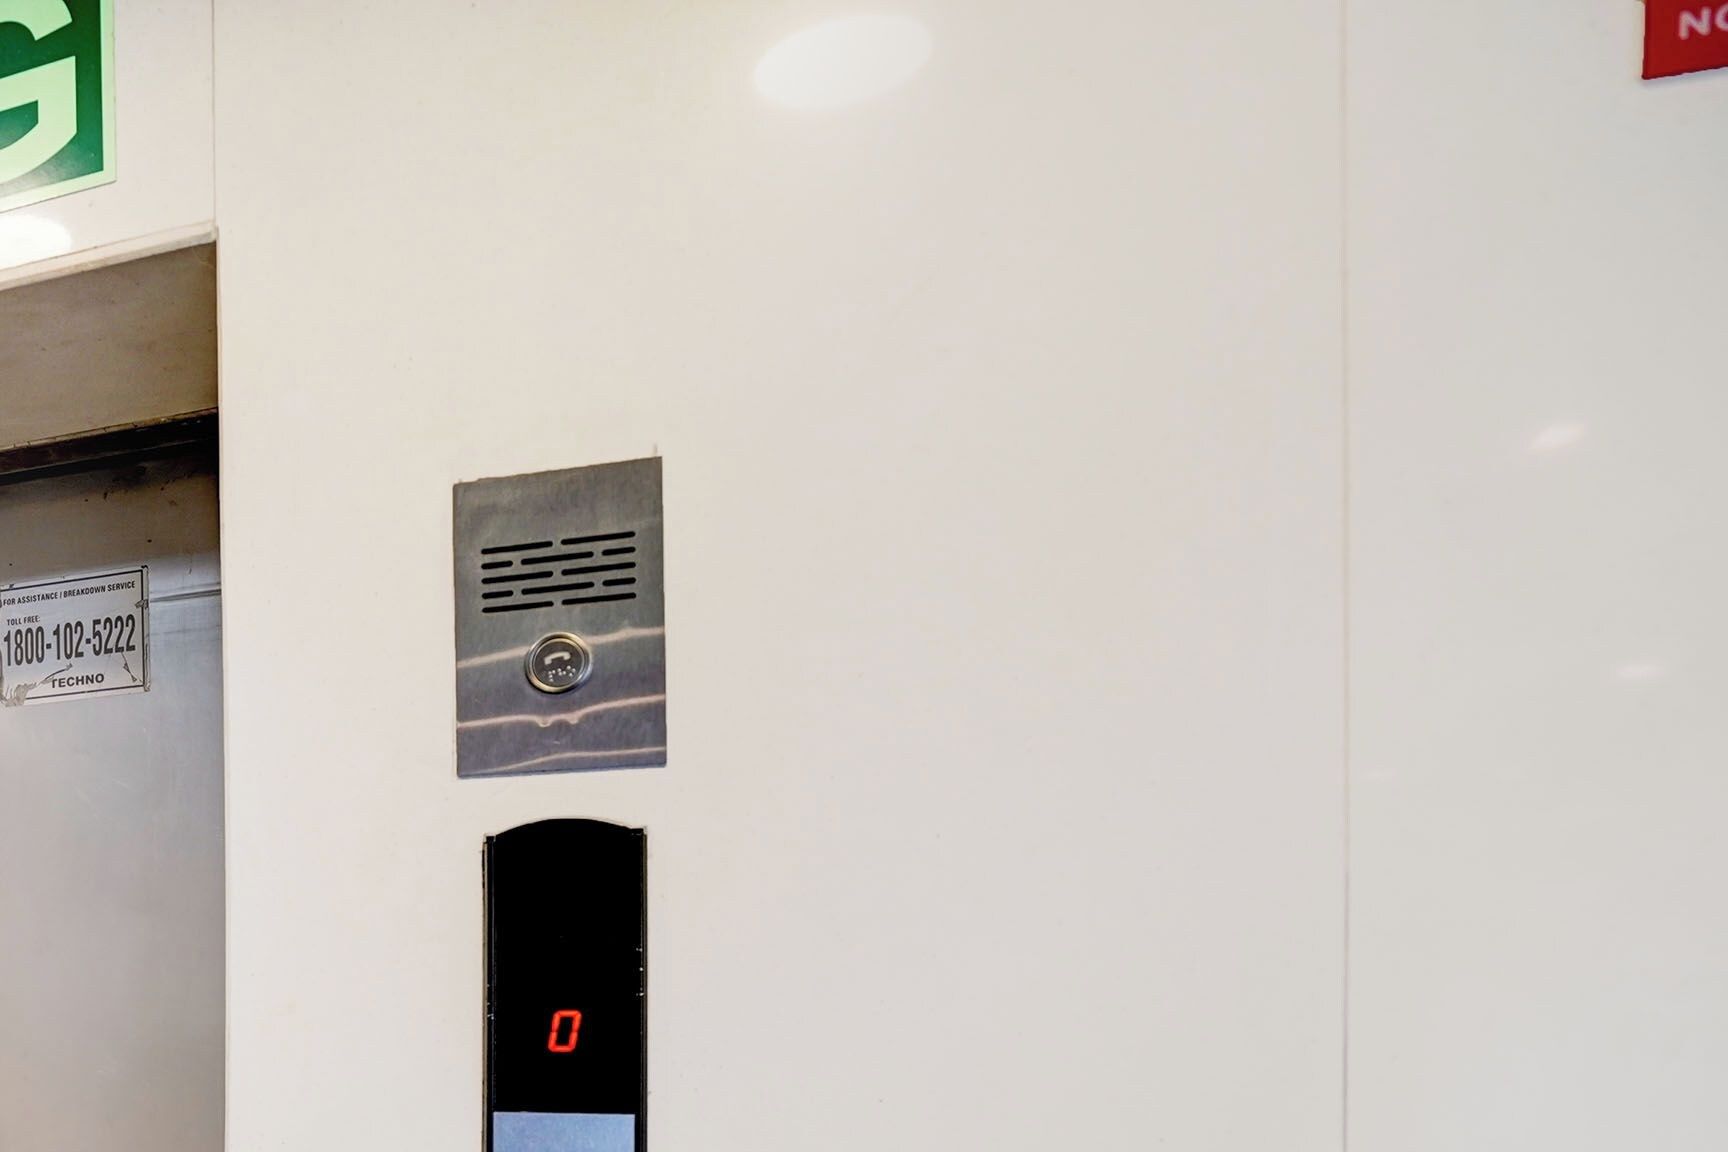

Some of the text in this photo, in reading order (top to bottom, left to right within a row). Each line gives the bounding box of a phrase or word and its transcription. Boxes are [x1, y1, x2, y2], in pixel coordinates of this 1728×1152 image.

[3, 598, 16, 606] FOR
[17, 592, 58, 604] ASSISTANCE
[63, 584, 106, 598] BREAKDOWN
[107, 580, 136, 592] SERVICE
[7, 615, 41, 626] TOLL FREE:
[3, 613, 136, 667] 1800-102-5222
[52, 673, 105, 689] TECHNO
[548, 1010, 582, 1052] 0
